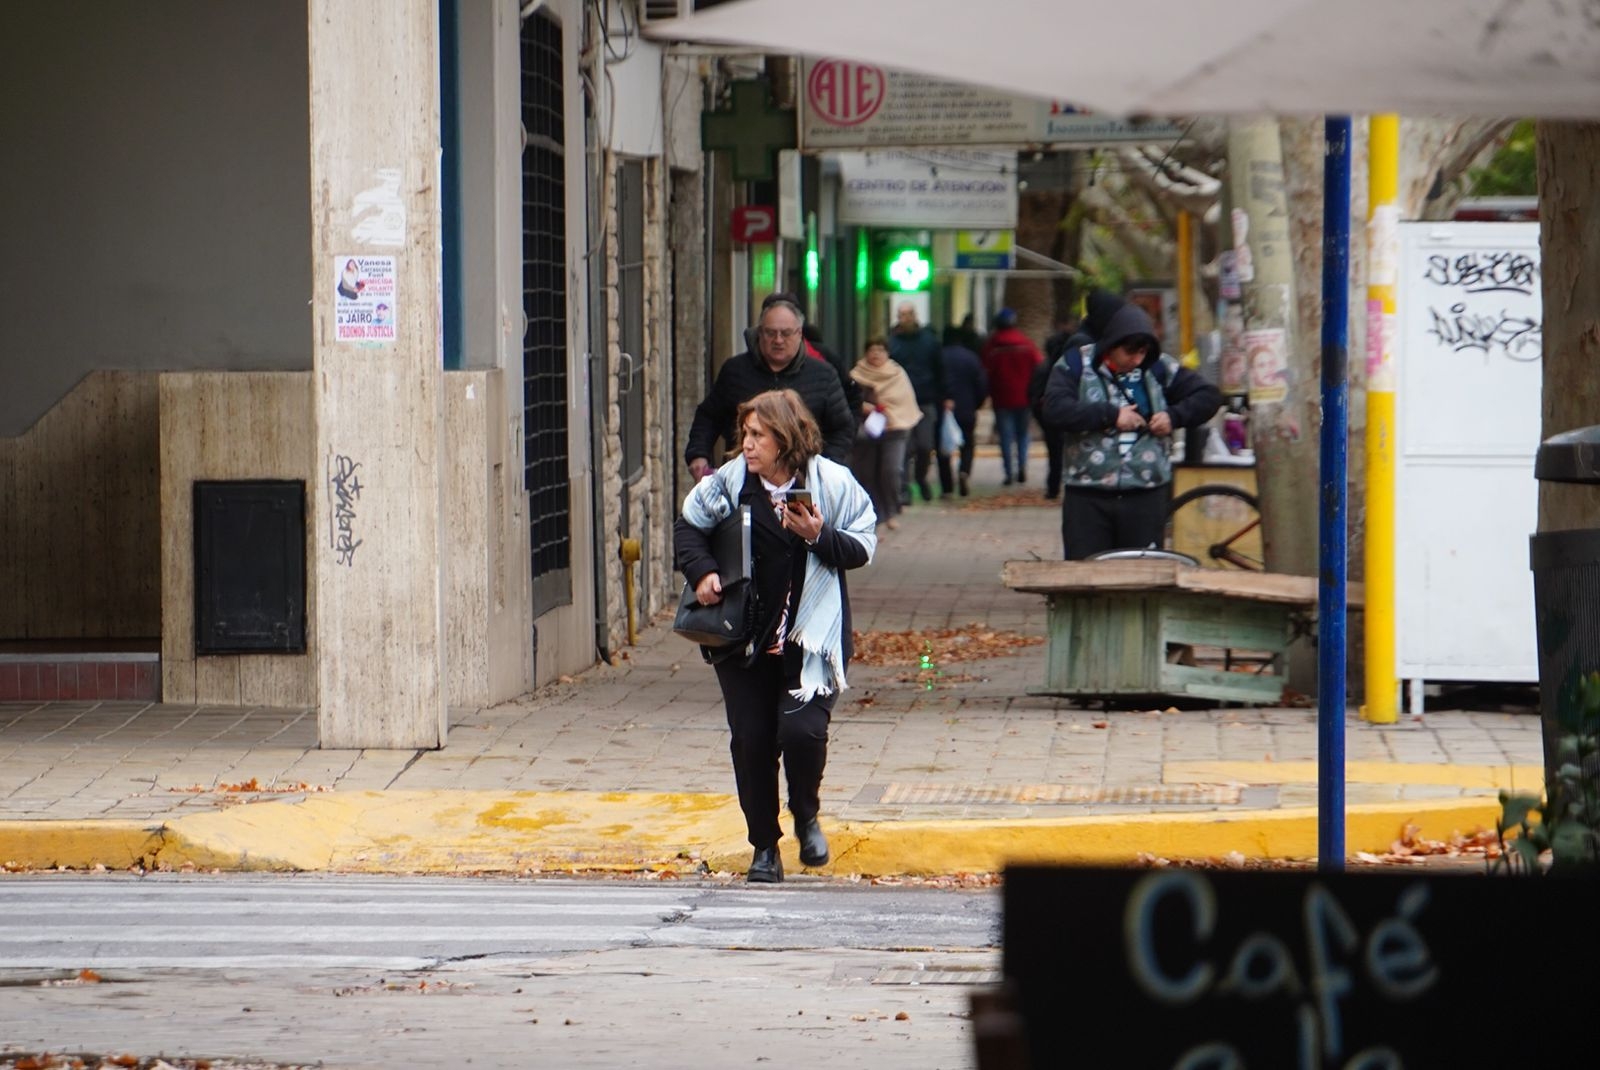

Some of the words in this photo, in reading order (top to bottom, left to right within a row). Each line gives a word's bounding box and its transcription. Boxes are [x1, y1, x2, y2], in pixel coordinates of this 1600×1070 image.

[849, 178, 905, 193] CENTRO
[345, 313, 372, 324] JAIRO
[339, 325, 365, 338] PEDIMOS
[366, 325, 394, 338] JUSTICIA
[1122, 868, 1438, 1057] Café
